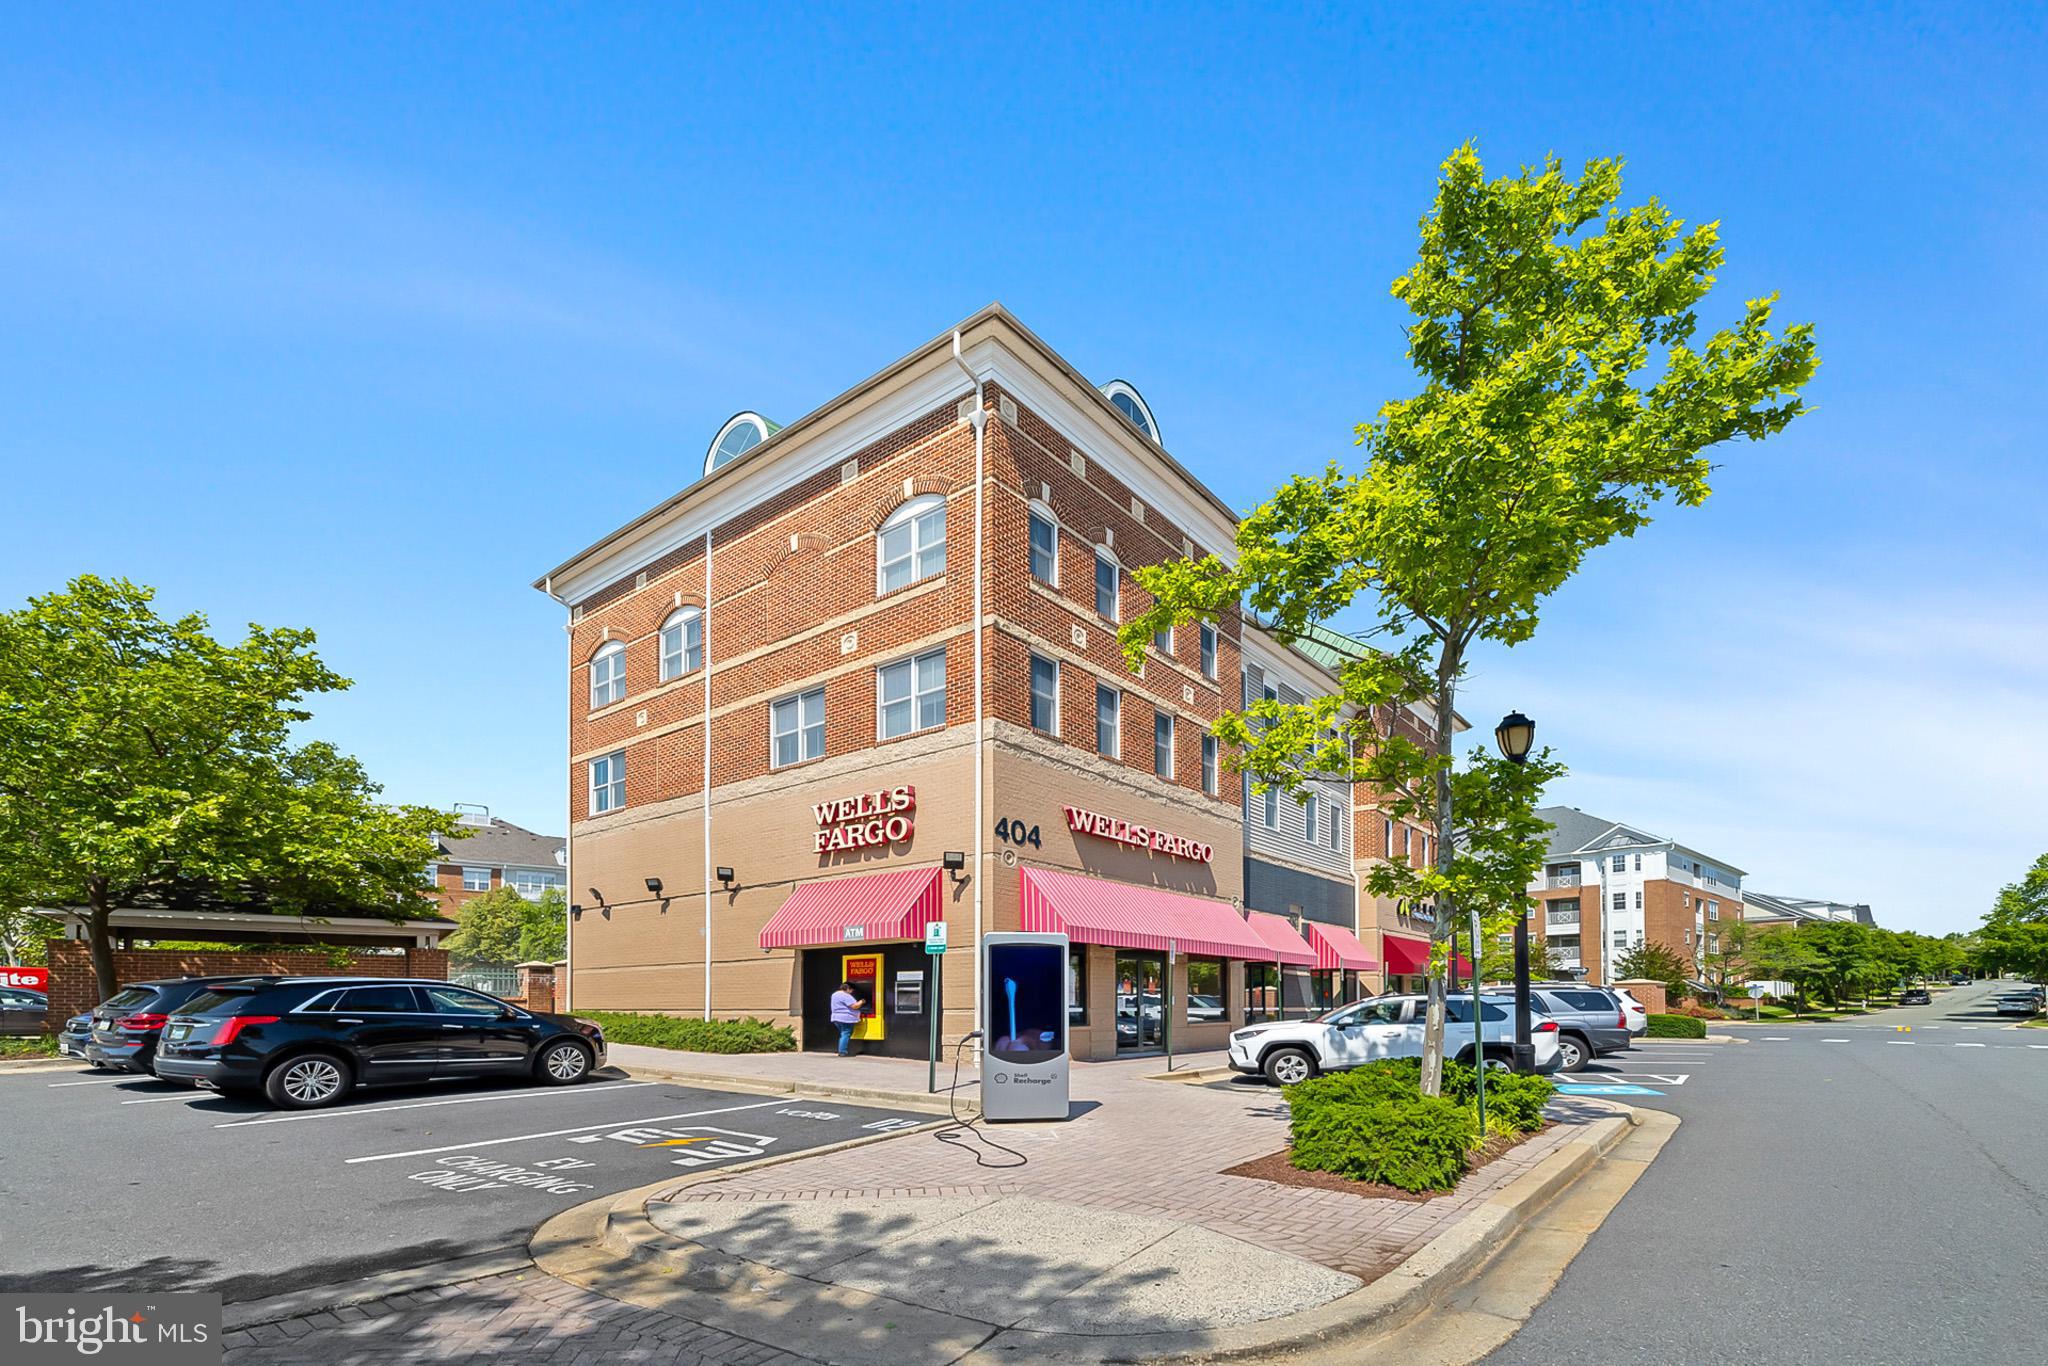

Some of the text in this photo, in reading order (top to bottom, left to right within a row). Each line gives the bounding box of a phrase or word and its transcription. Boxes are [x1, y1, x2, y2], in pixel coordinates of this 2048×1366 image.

[810, 785, 914, 826] WELLS
[812, 816, 914, 853] FARGO
[995, 817, 1042, 849] 404
[1066, 806, 1214, 863] WELLS FARGO
[844, 926, 864, 938] ATM
[1013, 1077, 1052, 1085] Recharge
[435, 1155, 595, 1194] CHARGING
[533, 1157, 597, 1171] EV
[407, 1170, 509, 1193] ONLY
